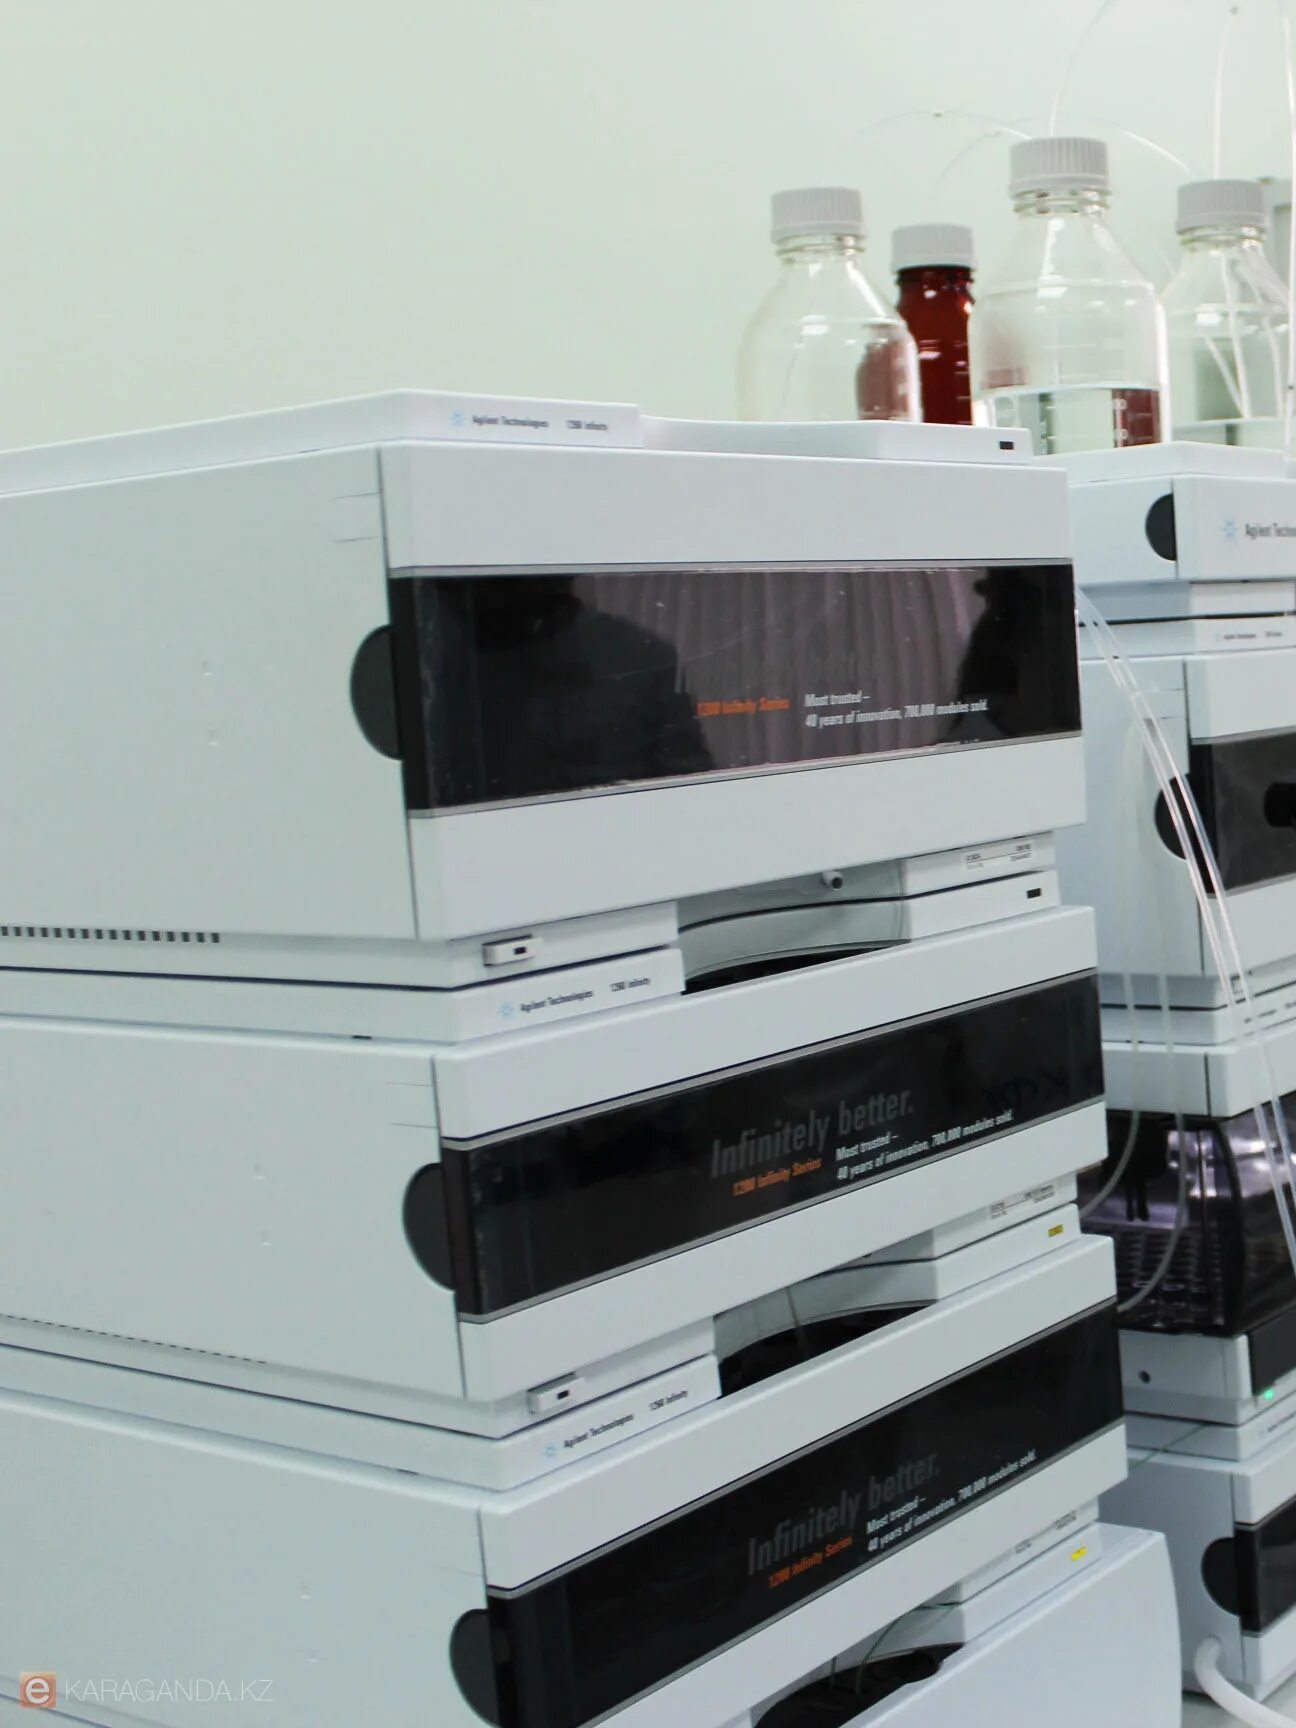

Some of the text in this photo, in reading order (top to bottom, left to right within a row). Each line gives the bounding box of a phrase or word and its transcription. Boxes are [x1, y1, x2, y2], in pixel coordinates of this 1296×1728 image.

[473, 415, 499, 426] Agilent
[502, 415, 549, 429] Technologies
[1245, 522, 1271, 540] Agilent
[721, 698, 757, 715] Infinity
[759, 697, 791, 710] Series
[804, 693, 829, 707] Most
[829, 689, 863, 705] trusted
[818, 714, 844, 729] years
[845, 710, 860, 724] of
[935, 701, 969, 715] modules
[521, 1000, 546, 1012] Agilent
[547, 990, 593, 1005] Technologies
[710, 1089, 914, 1178] Infinitely better.
[836, 1144, 859, 1161] Most
[859, 1131, 891, 1154] trusted
[849, 1160, 874, 1178] years
[875, 1151, 889, 1168] of
[961, 1117, 995, 1137] modules
[757, 1167, 792, 1188] Infinity
[791, 1157, 822, 1177] Series
[564, 1433, 588, 1448] Agilent
[589, 1414, 634, 1435] Technologies
[748, 1453, 941, 1576] Infinitely better.
[866, 1513, 889, 1535] Most
[889, 1495, 920, 1522] trusted
[880, 1526, 904, 1549] years
[987, 1460, 1019, 1486] modules
[791, 1551, 824, 1576] Infinity
[824, 1535, 854, 1557] Series
